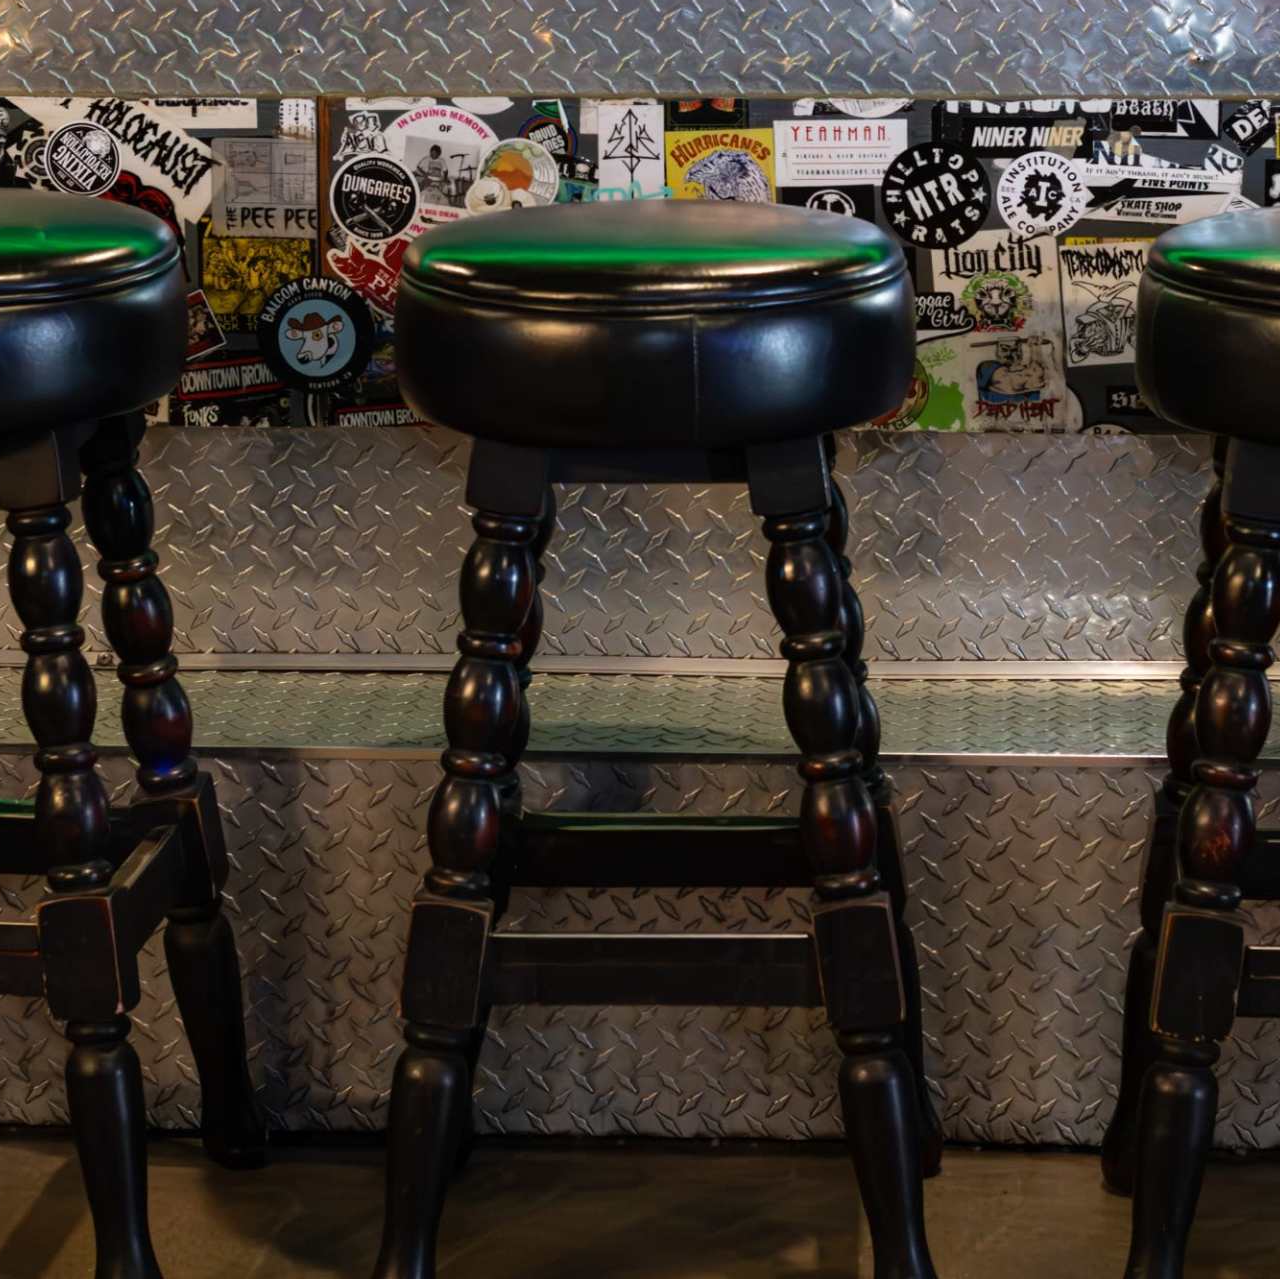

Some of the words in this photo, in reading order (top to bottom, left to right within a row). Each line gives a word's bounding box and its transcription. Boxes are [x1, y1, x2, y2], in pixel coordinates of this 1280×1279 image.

[397, 119, 409, 129] IN
[410, 109, 447, 122] LOVING
[449, 111, 490, 141] MEMORY
[439, 124, 453, 133] OF
[528, 123, 558, 141] DAVID
[971, 126, 1027, 148] NINER
[1029, 126, 1085, 148] NINER
[670, 132, 771, 169] HURRICANES
[52, 146, 98, 192] VIKING
[885, 147, 979, 203] HILLTOP
[1005, 155, 1083, 194] INSTITUTION
[342, 173, 412, 204] DUNGAREES
[904, 172, 966, 222] HTR
[1169, 181, 1209, 190] POINTS
[226, 206, 238, 231] THE
[240, 206, 277, 229] PEE
[284, 207, 318, 230] PEE
[1001, 196, 1015, 220] ALE
[1017, 206, 1080, 235] COPANY
[1121, 200, 1153, 211] SKATE
[1155, 201, 1183, 212] SHOP
[910, 205, 981, 244] RATS
[939, 245, 990, 280] Lion
[262, 282, 300, 323] BALCOM
[302, 277, 352, 300] CANYON
[930, 307, 968, 329] Girl
[181, 371, 241, 394] DOWNTOWN
[339, 409, 395, 427] DOWNTOWN
